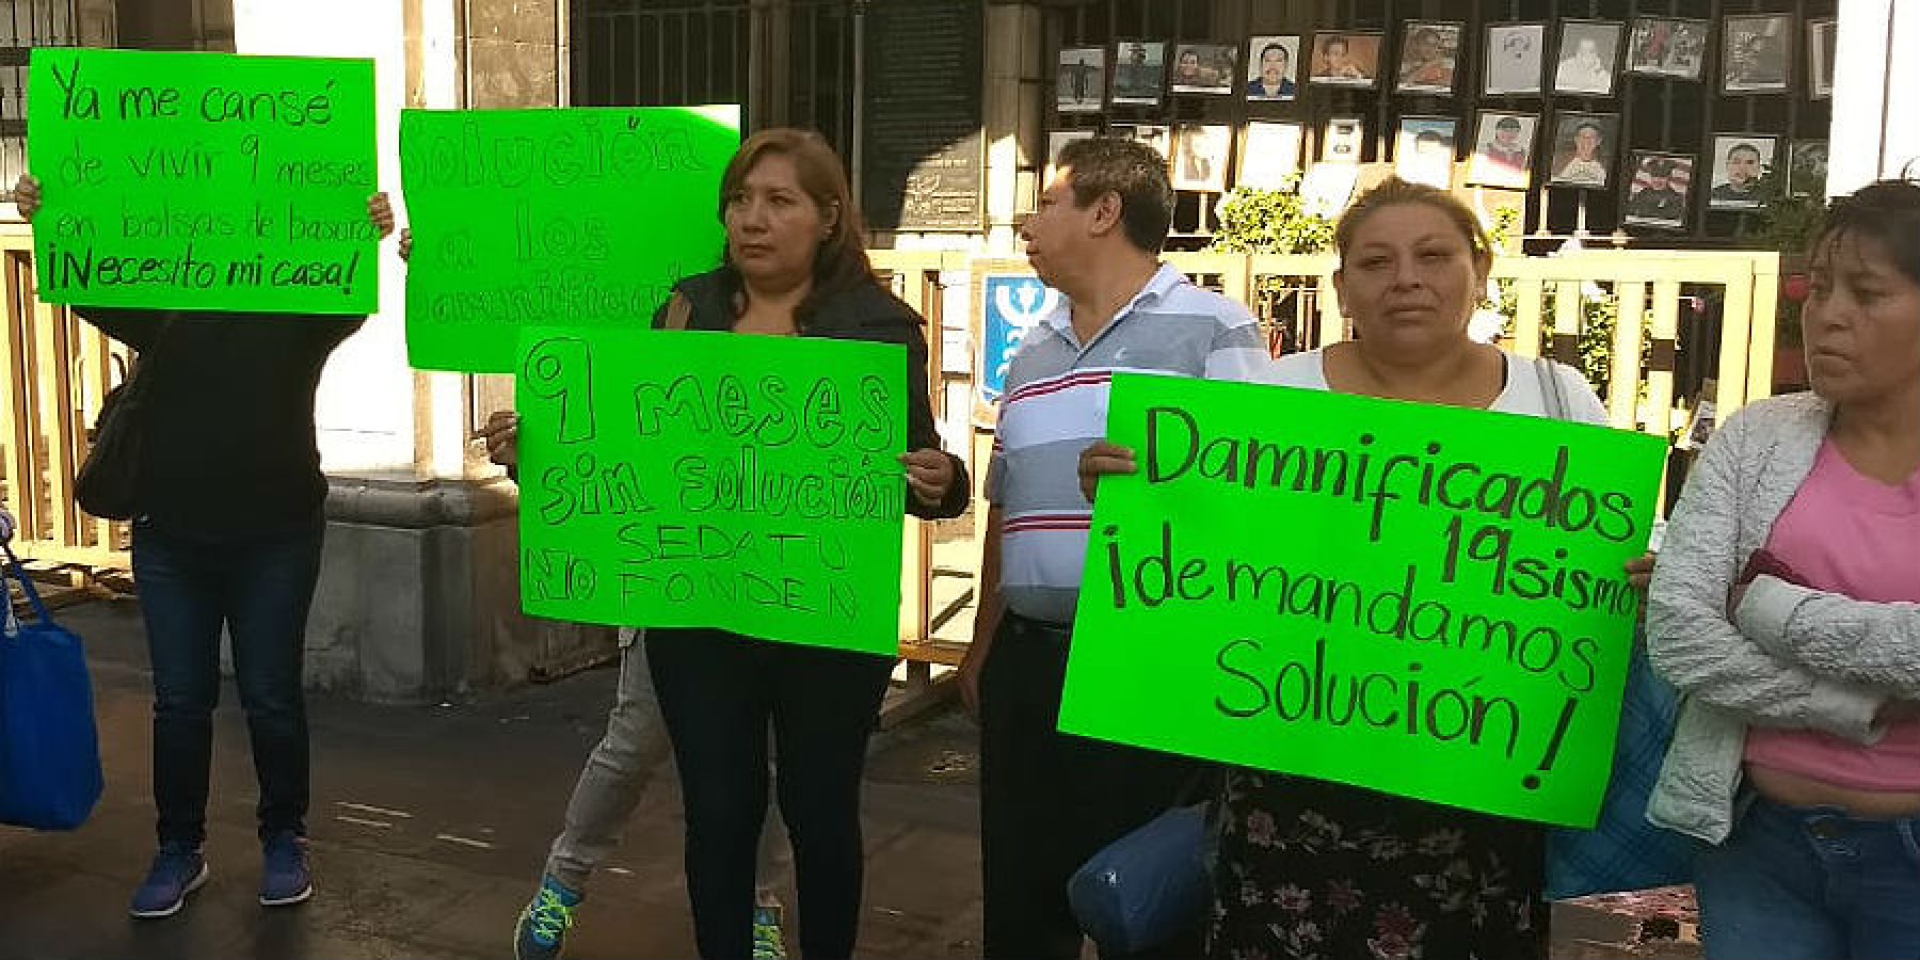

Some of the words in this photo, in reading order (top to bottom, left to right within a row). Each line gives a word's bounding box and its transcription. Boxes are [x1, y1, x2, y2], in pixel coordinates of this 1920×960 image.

[51, 57, 100, 120] Ya
[119, 86, 180, 120] me
[201, 78, 336, 127] cansé
[59, 136, 106, 188] de
[127, 142, 222, 179] vivir
[240, 133, 260, 185] 9
[276, 157, 374, 189] meses
[56, 212, 97, 240] en
[121, 194, 236, 240] bolsas
[247, 199, 275, 239] de
[289, 200, 377, 245] basura
[515, 198, 610, 263] los
[226, 252, 264, 287] mi
[271, 249, 360, 296] casa!
[525, 336, 595, 444] 9
[1145, 406, 1636, 542] Damnificados
[616, 523, 847, 572] SEDATU
[525, 549, 597, 601] NO
[616, 573, 857, 620] FONDEN
